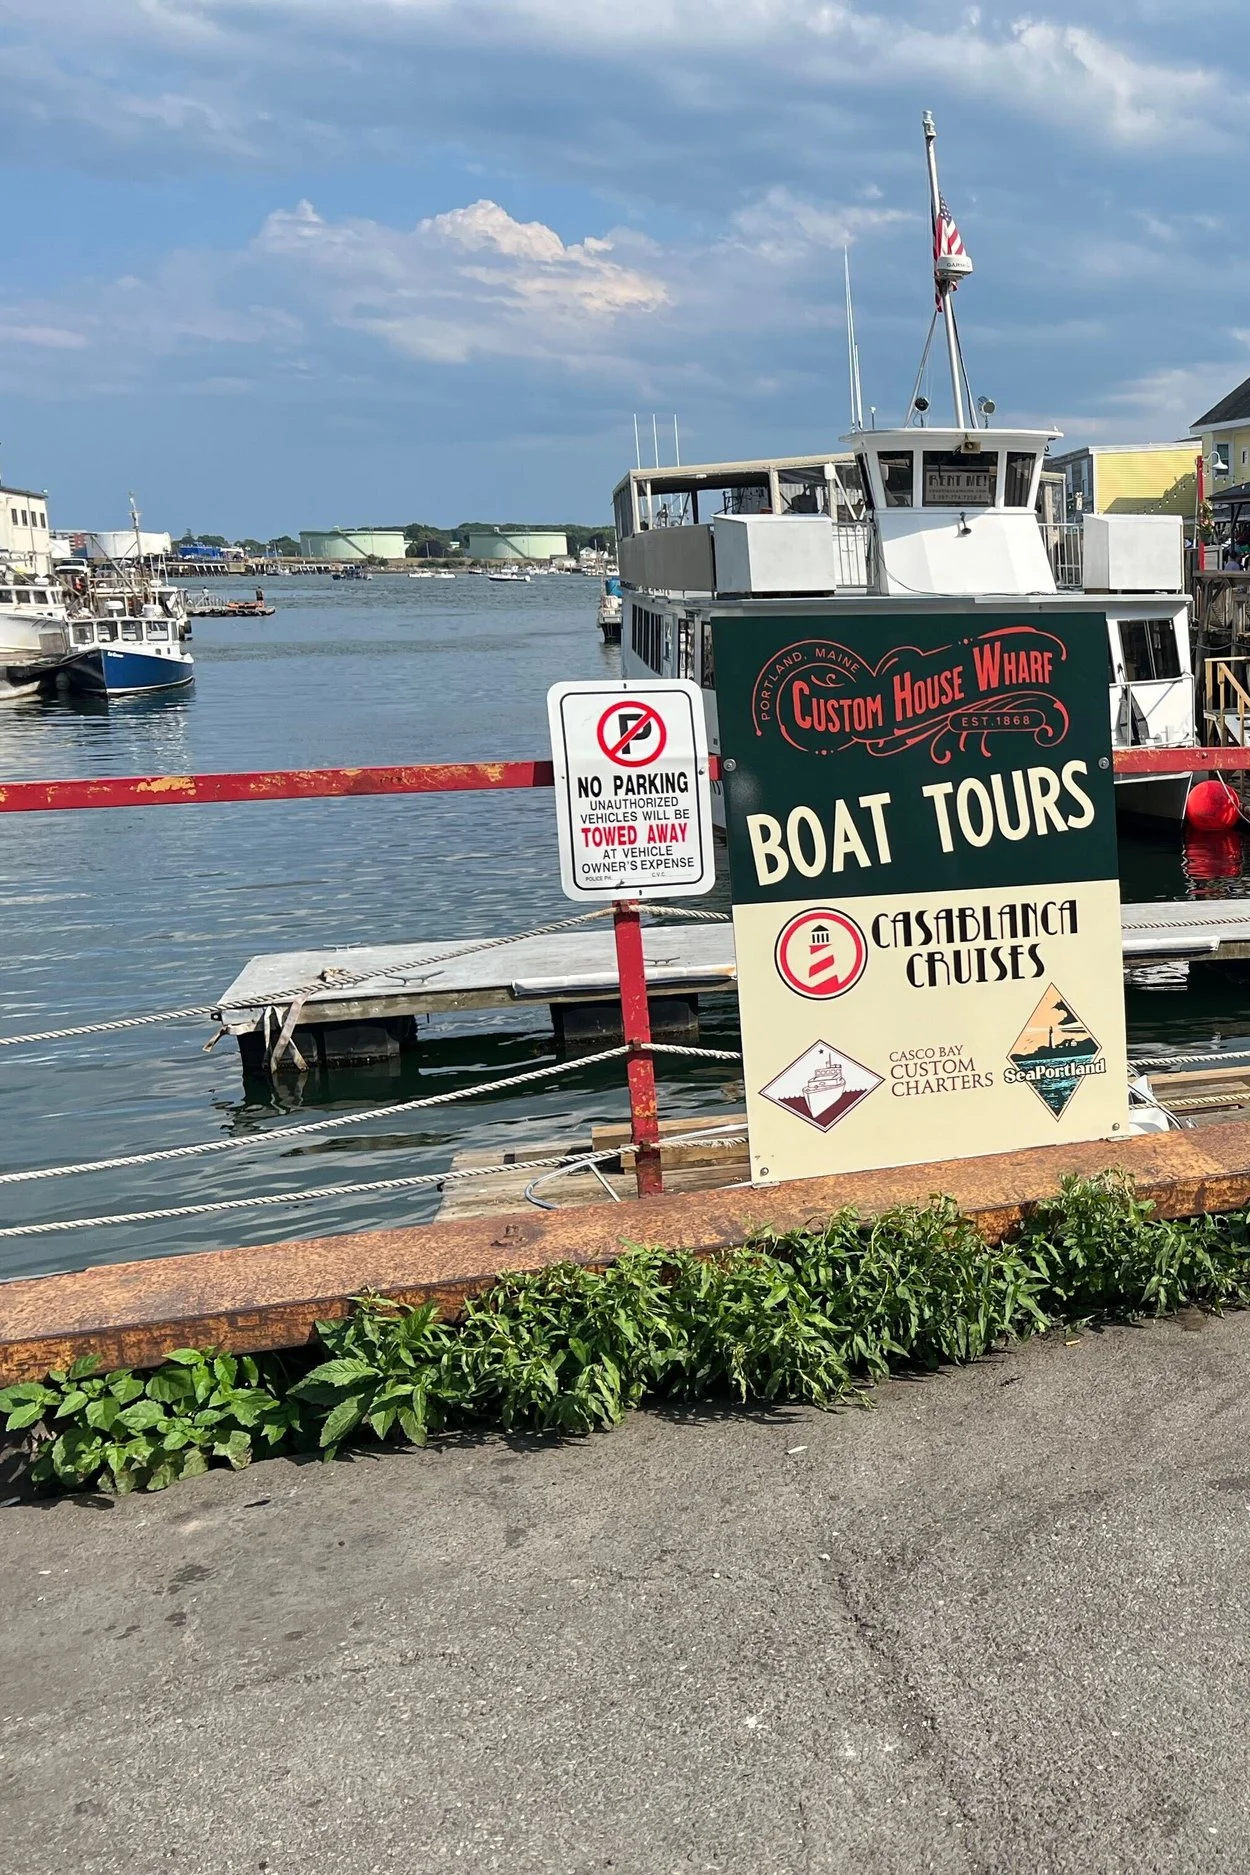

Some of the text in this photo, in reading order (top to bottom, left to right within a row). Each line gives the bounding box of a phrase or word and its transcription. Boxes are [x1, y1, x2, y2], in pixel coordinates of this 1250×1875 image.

[929, 475, 987, 487] RENT ME!
[760, 648, 860, 721] PORTLAND, MAINE
[792, 641, 1053, 733] CUSTOM HOUSE WHARF
[577, 772, 689, 798] NO PARKING
[590, 796, 679, 811] UNAUTHORIZED
[580, 809, 690, 825] VEHICLES WILL BE
[746, 760, 1095, 886] BOAT TOURS
[581, 823, 688, 847] TOWED AWAY
[603, 846, 673, 860] AT VEHICLE
[581, 857, 695, 874] OWNER'S EXPENSE
[871, 899, 1078, 948] CASABLANCA
[906, 943, 1045, 988] CRUISES
[889, 1044, 964, 1063] CASCO BAY
[890, 1057, 976, 1080] CUSTOM
[1003, 1058, 1107, 1084] SeaPortland
[891, 1072, 994, 1097] CHARTERS
